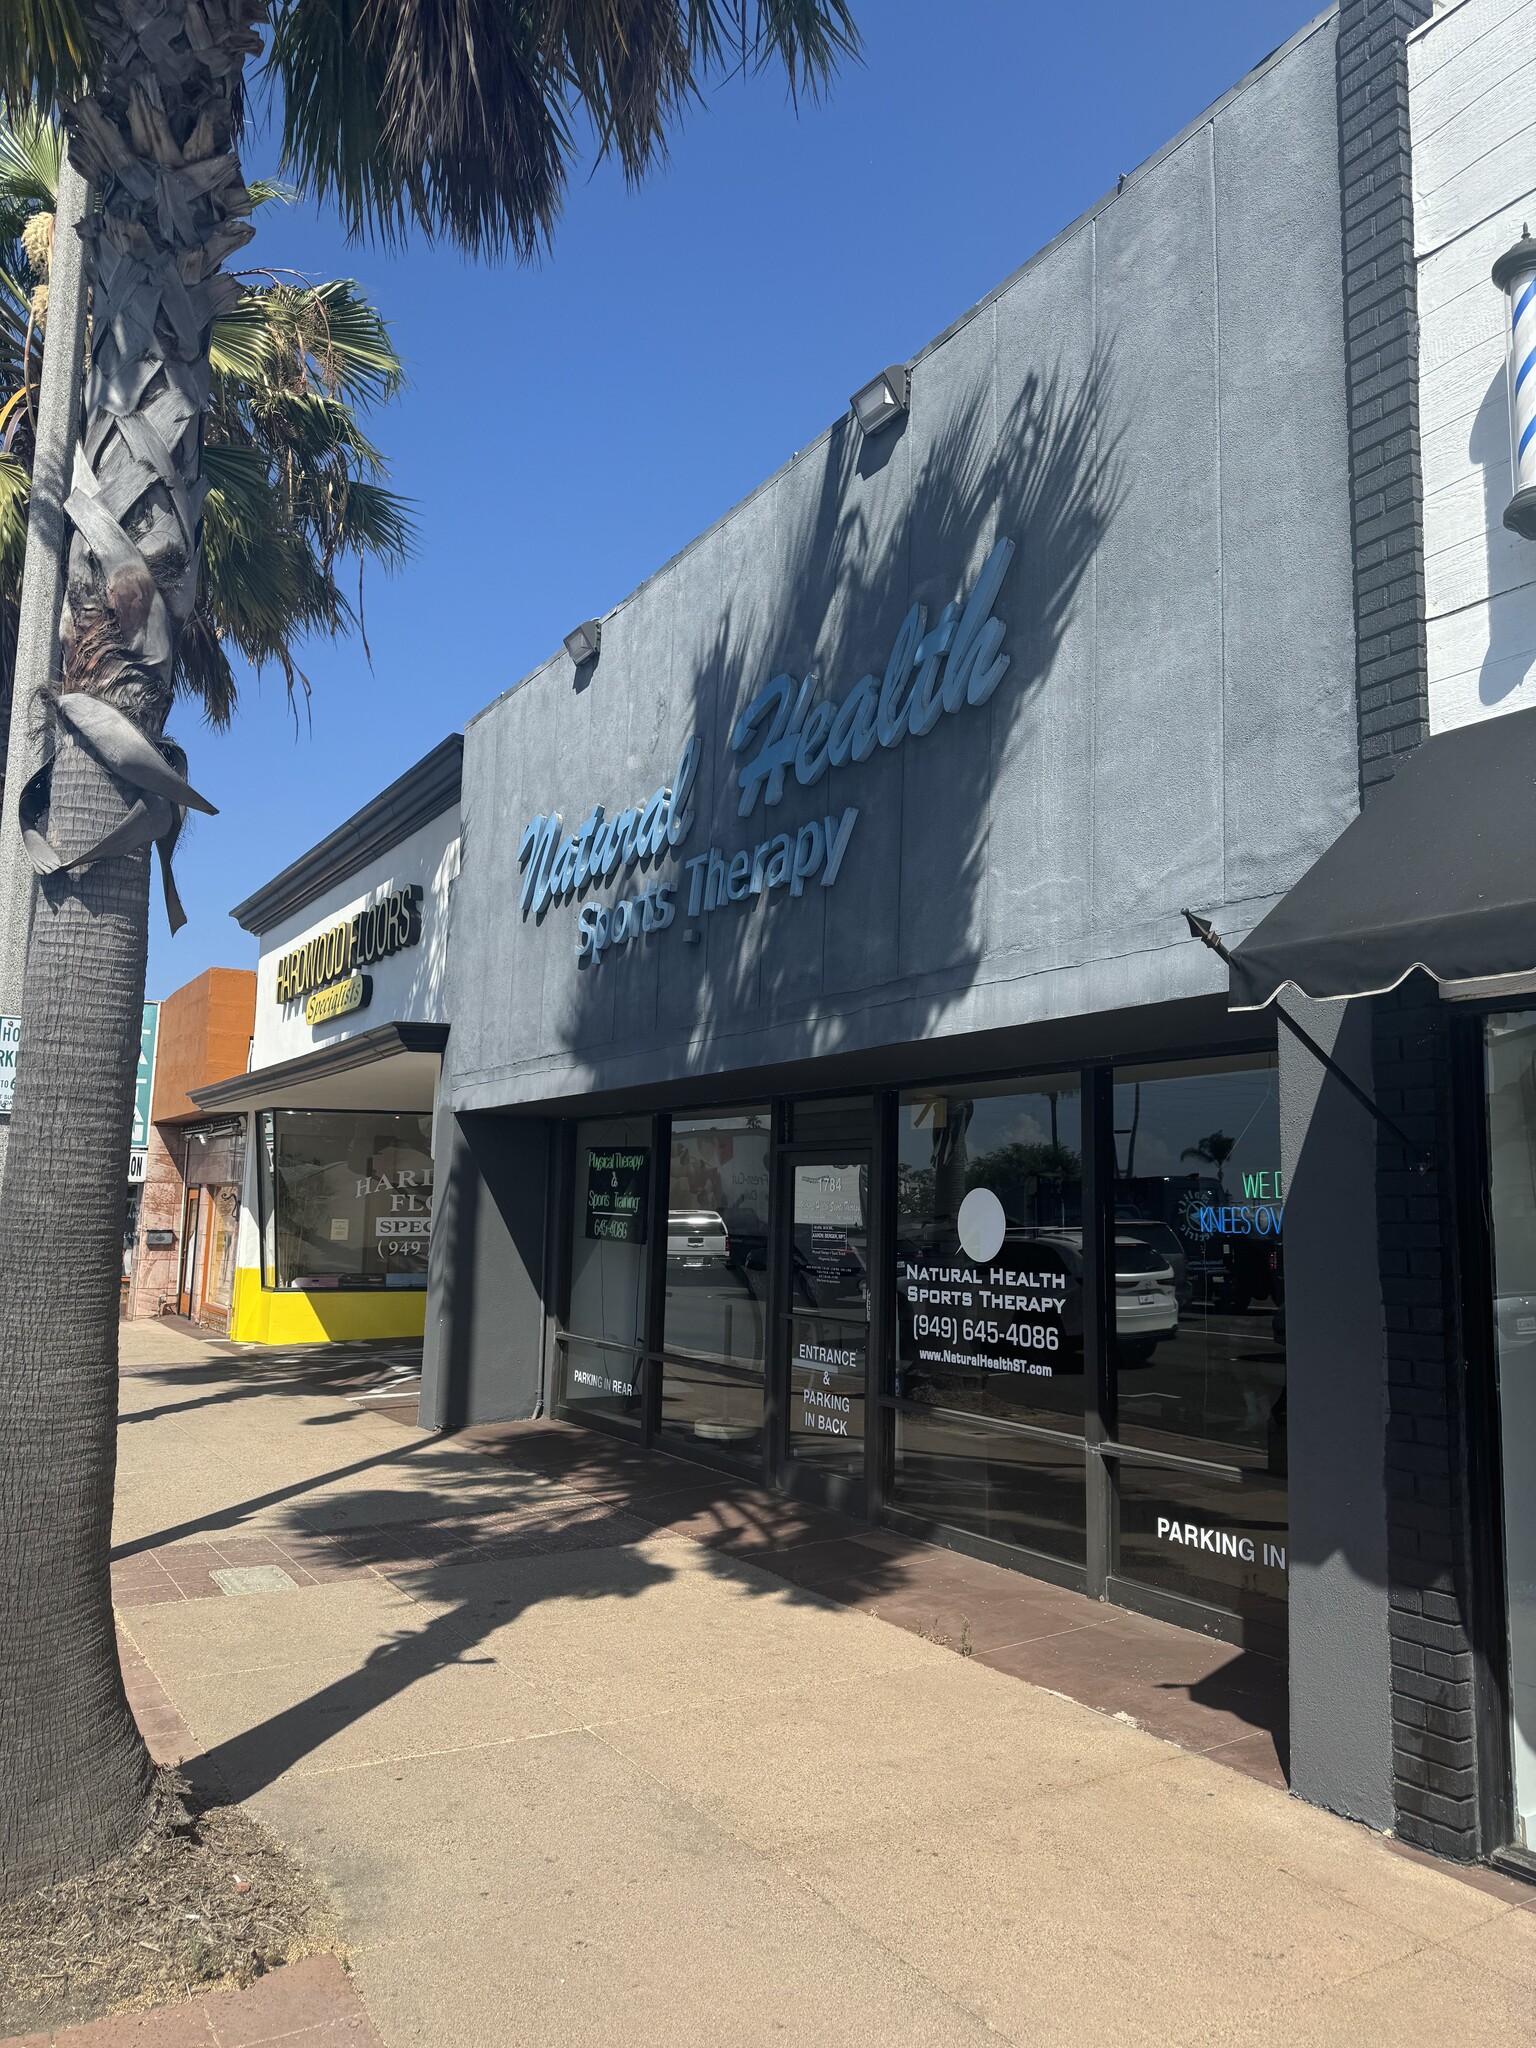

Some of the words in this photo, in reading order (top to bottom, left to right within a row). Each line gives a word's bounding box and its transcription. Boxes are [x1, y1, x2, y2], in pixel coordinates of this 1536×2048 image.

[516, 736, 700, 913] Natural
[732, 536, 1016, 818] Health
[575, 879, 678, 965] Sports
[686, 806, 859, 917] Therapy
[276, 921, 351, 1004] HARDWOOD
[348, 883, 423, 970] FLOORS
[307, 979, 362, 1023] Specialists
[588, 1151, 615, 1171] Physical
[615, 1152, 645, 1171] Therapy
[818, 1177, 842, 1192] 1784
[1241, 1171, 1271, 1199] WE
[588, 1189, 611, 1210] Sports
[614, 1191, 641, 1213] Training
[593, 1218, 628, 1239] 645-4086
[1199, 1205, 1252, 1235] KNEES
[913, 1313, 958, 1345] (949)
[962, 1319, 1060, 1351] 645-4086
[799, 1343, 857, 1368] ENTRANCE
[919, 1349, 1053, 1378] www.NaturalHealthST.com
[574, 1369, 603, 1389] PARKING
[603, 1377, 612, 1391] IN
[612, 1379, 633, 1397] REAR
[822, 1370, 831, 1386] &
[803, 1388, 850, 1414] PARKING
[804, 1411, 816, 1428] IN
[818, 1414, 849, 1437] BACK
[1157, 1516, 1256, 1563] PARKING
[1262, 1542, 1287, 1570] IN
